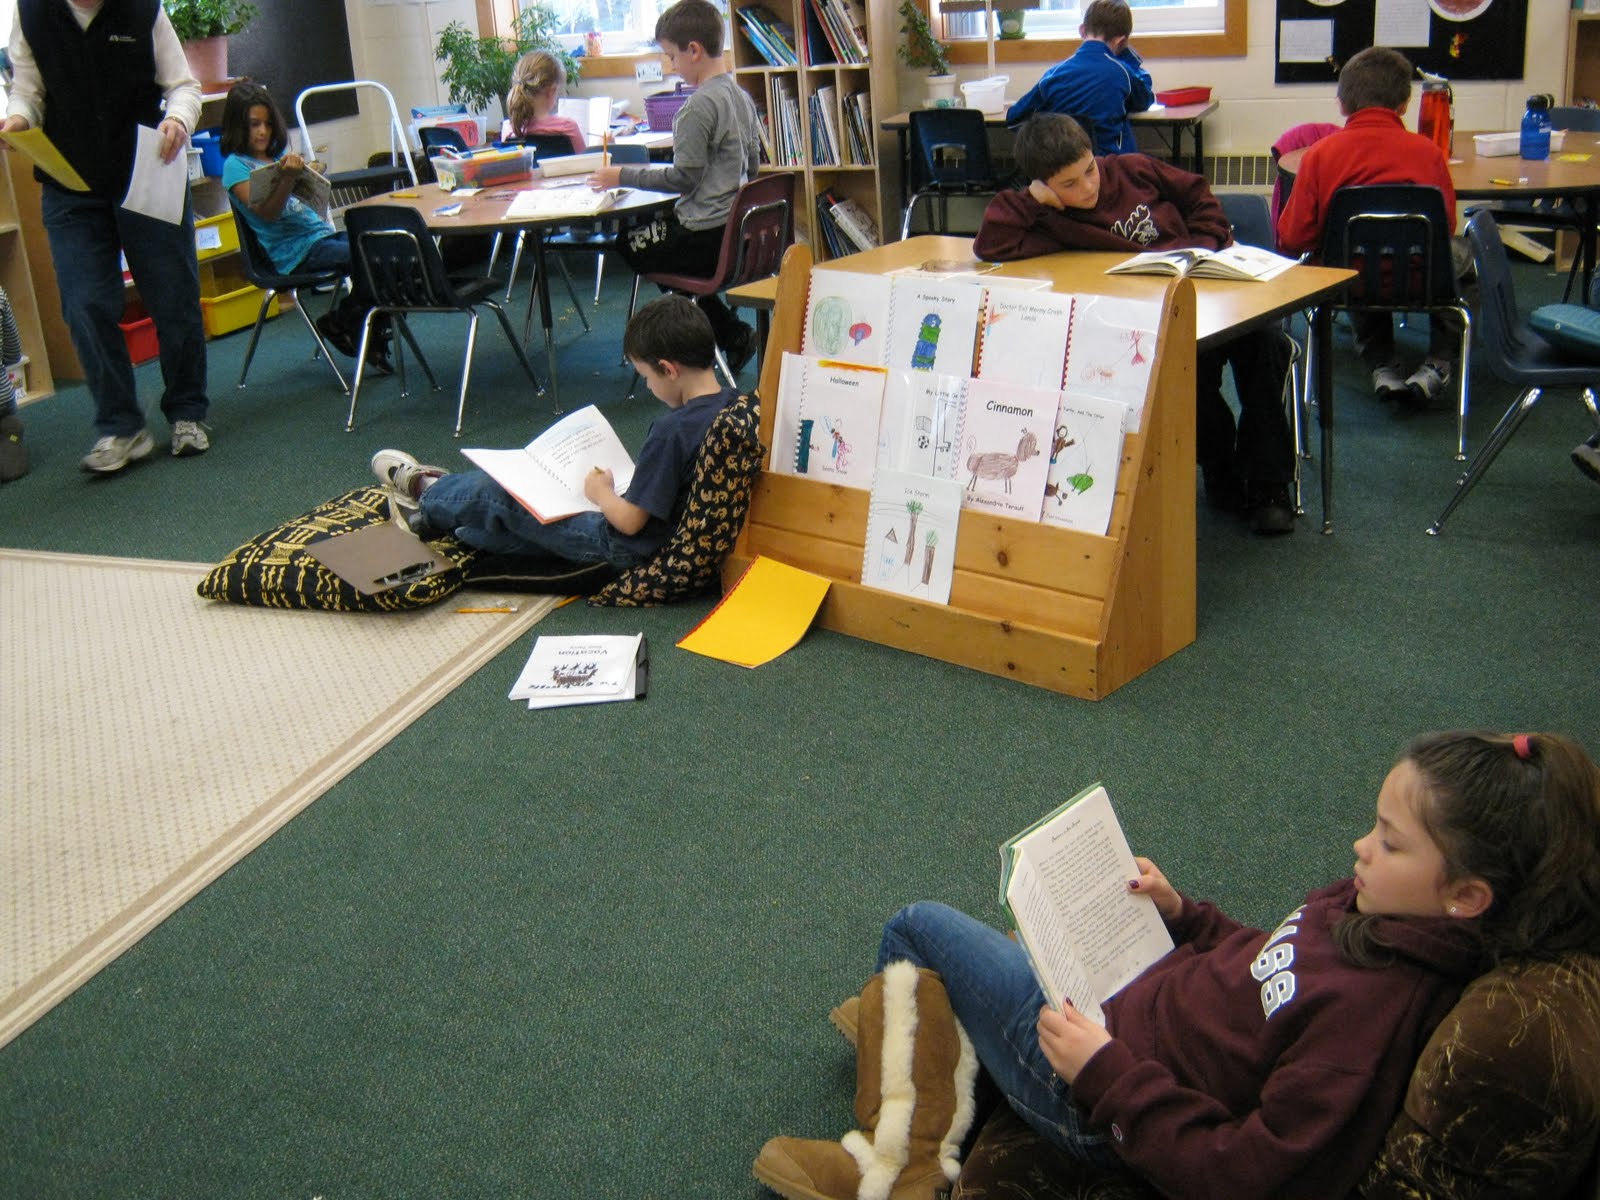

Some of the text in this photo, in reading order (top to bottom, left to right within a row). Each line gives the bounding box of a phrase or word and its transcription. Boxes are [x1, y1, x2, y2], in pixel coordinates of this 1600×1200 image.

[941, 296, 955, 304] Story
[829, 376, 859, 388] Halloween
[986, 400, 1033, 417] Cinnamon
[967, 495, 974, 503] By
